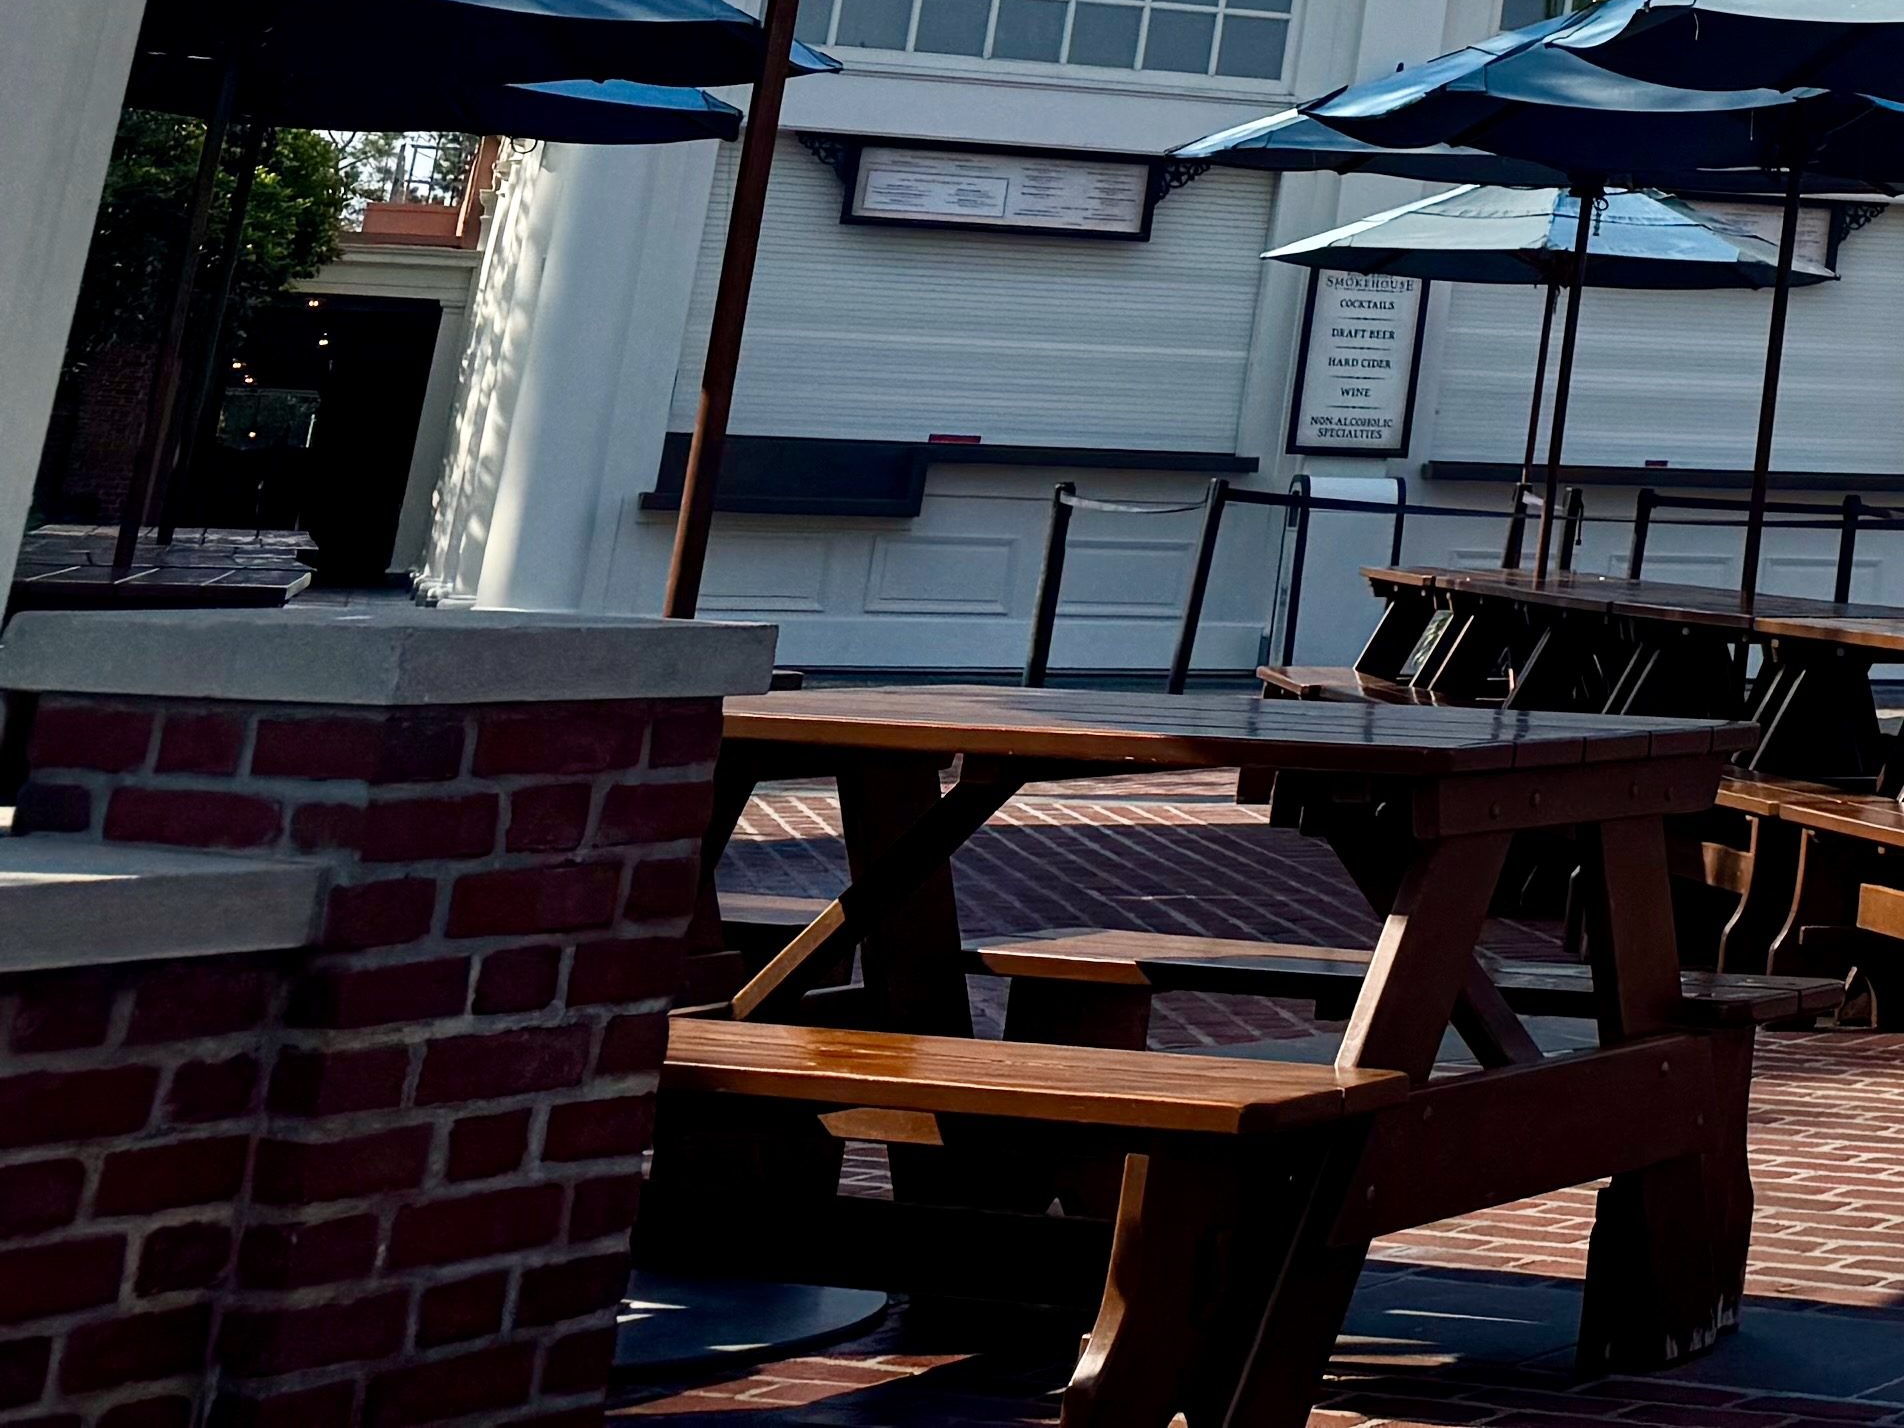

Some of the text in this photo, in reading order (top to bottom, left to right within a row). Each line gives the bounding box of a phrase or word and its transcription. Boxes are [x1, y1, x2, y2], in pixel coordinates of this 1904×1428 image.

[1339, 298, 1395, 310] COCKTAILS
[1331, 327, 1395, 340] DRAFT BEER
[1328, 356, 1392, 369] HARD CIDER
[1340, 387, 1372, 398] WINE
